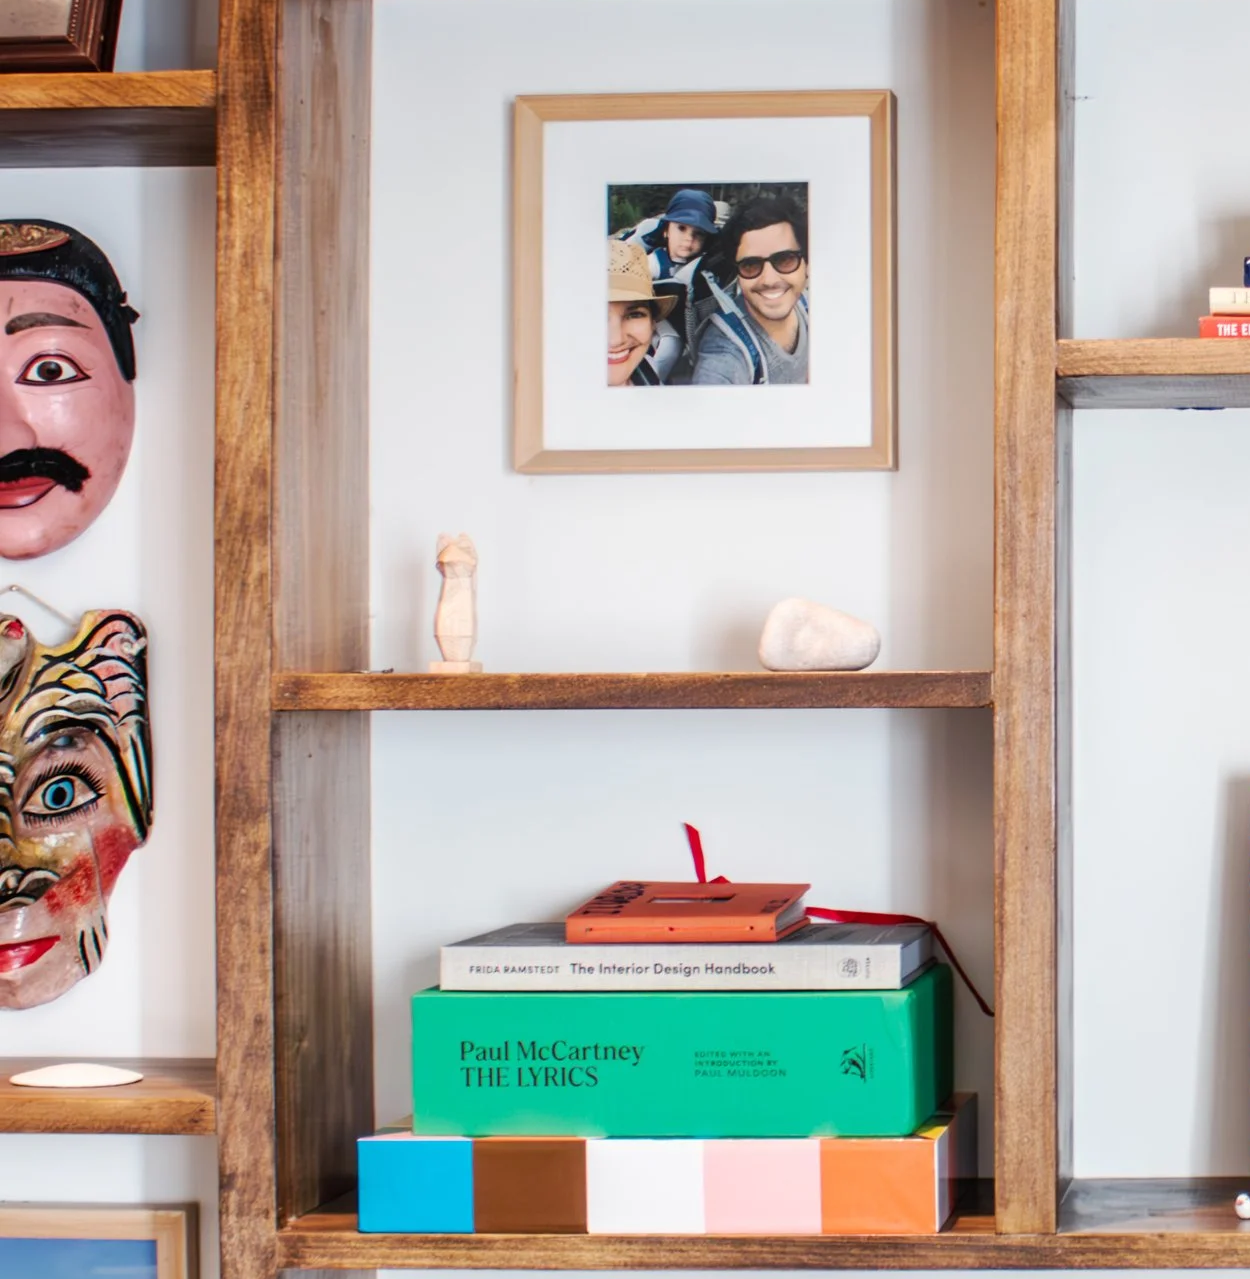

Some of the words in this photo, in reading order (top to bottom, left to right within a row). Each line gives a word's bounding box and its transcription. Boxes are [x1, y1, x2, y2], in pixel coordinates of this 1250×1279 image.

[1217, 323, 1237, 336] THE
[469, 965, 501, 974] FRIDA
[503, 965, 560, 974] RAMSTEDT
[570, 963, 595, 975] The
[599, 962, 650, 975] Interior
[653, 963, 700, 978] Design
[705, 962, 776, 975] Handbook
[460, 1040, 510, 1061] Paul
[516, 1040, 645, 1067] McCartney
[460, 1066, 510, 1087] THE
[516, 1066, 599, 1087] LYRICS
[694, 1069, 723, 1078] PAUL
[727, 1069, 787, 1078] MULDOON
